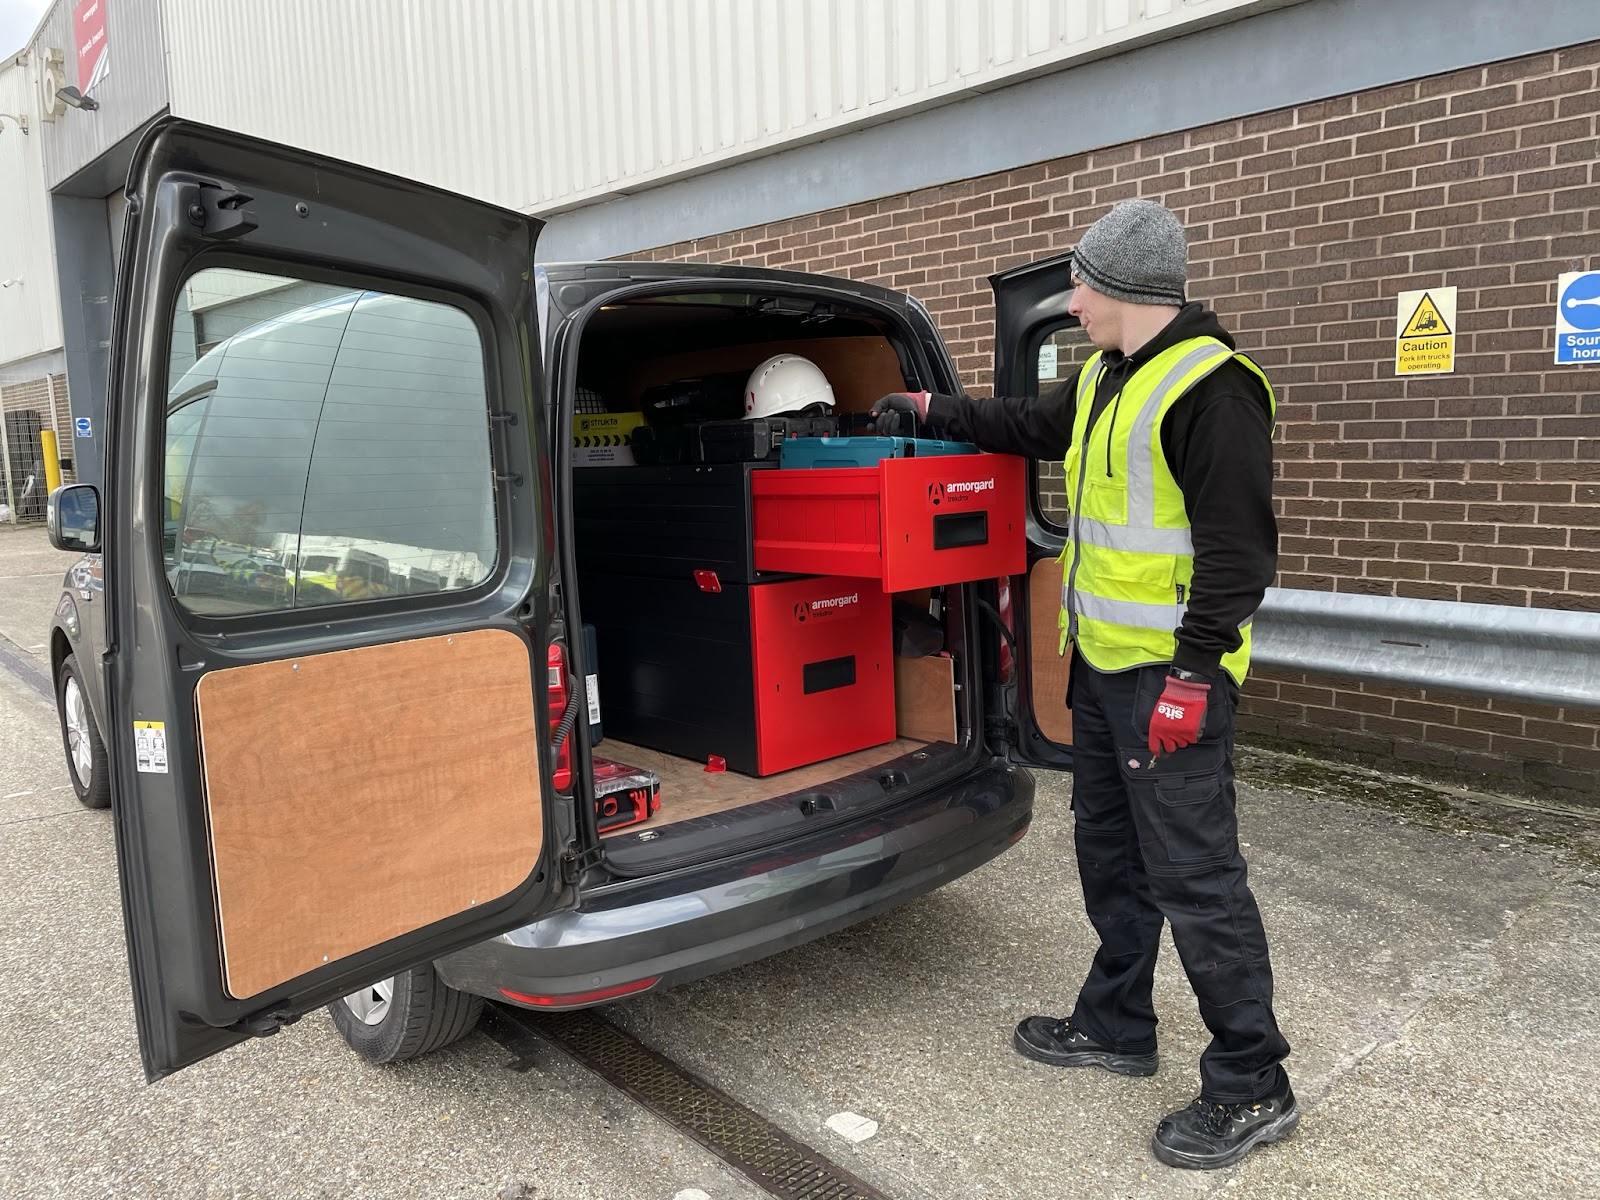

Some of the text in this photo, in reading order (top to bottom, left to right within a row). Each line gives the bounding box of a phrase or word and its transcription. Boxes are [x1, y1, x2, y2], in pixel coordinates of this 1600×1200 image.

[1402, 341, 1448, 352] Caution
[1407, 362, 1441, 370] operating
[590, 418, 618, 426] strukta
[946, 477, 994, 493] armorgard
[812, 593, 858, 610] armorgard
[1158, 705, 1183, 719] site
